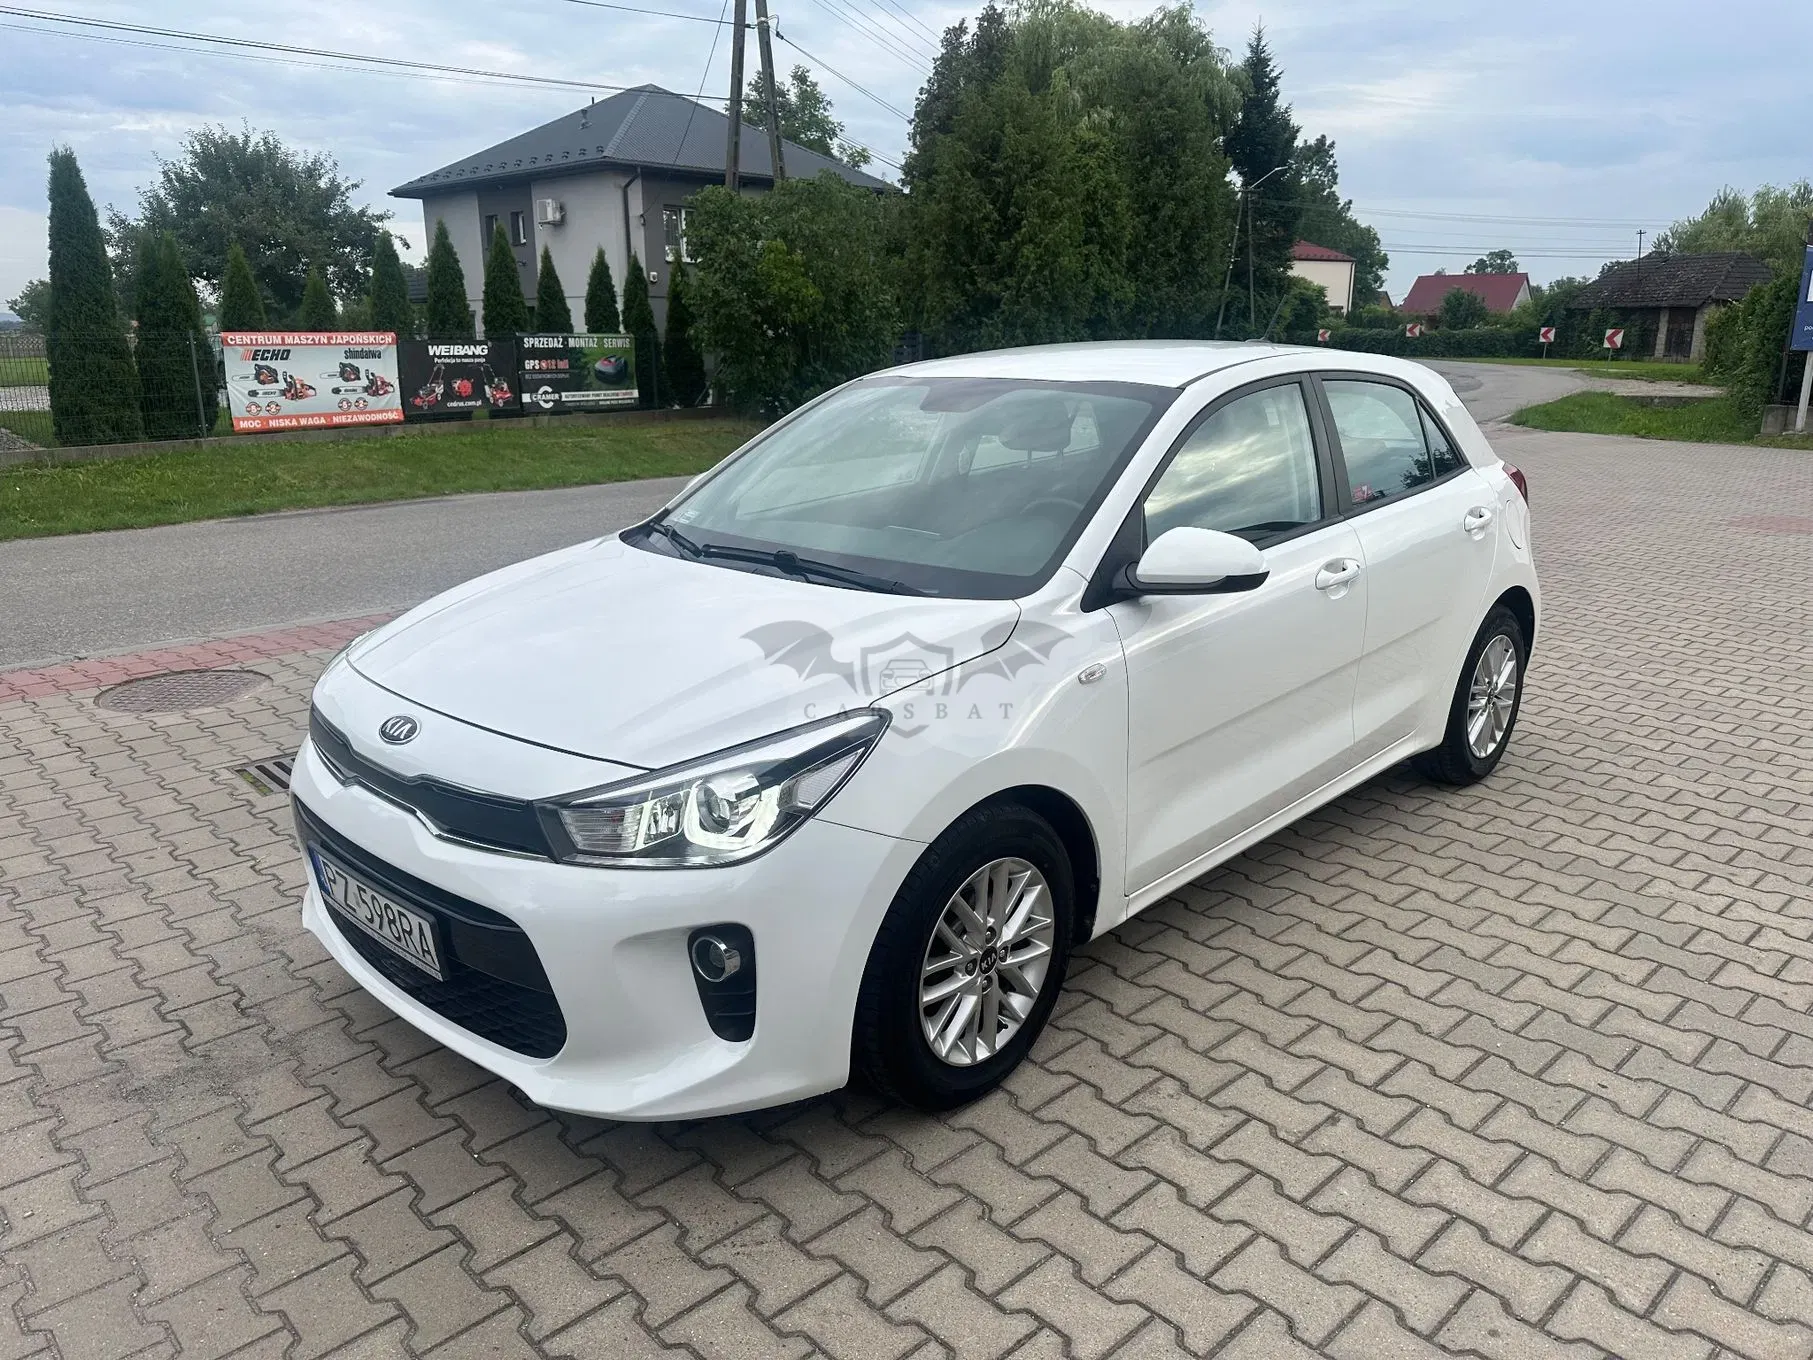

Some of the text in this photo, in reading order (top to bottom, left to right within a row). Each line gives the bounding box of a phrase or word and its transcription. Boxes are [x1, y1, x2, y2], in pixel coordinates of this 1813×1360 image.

[227, 333, 392, 345] CENTRUM MASZYN JAPOŃSKICH
[523, 336, 630, 348] SPRZEDAŻ MONTAŻ SERWIS
[251, 348, 291, 361] ECHO
[344, 347, 382, 360] shindaiwa
[428, 345, 488, 356] WEIBANG
[524, 359, 540, 370] GPS
[532, 393, 560, 401] CRAMER
[239, 411, 399, 429] MOC NISKA WAGA NIEZAWODNOŚĆ
[356, 883, 437, 967] 598RA
[980, 953, 997, 971] KIA
